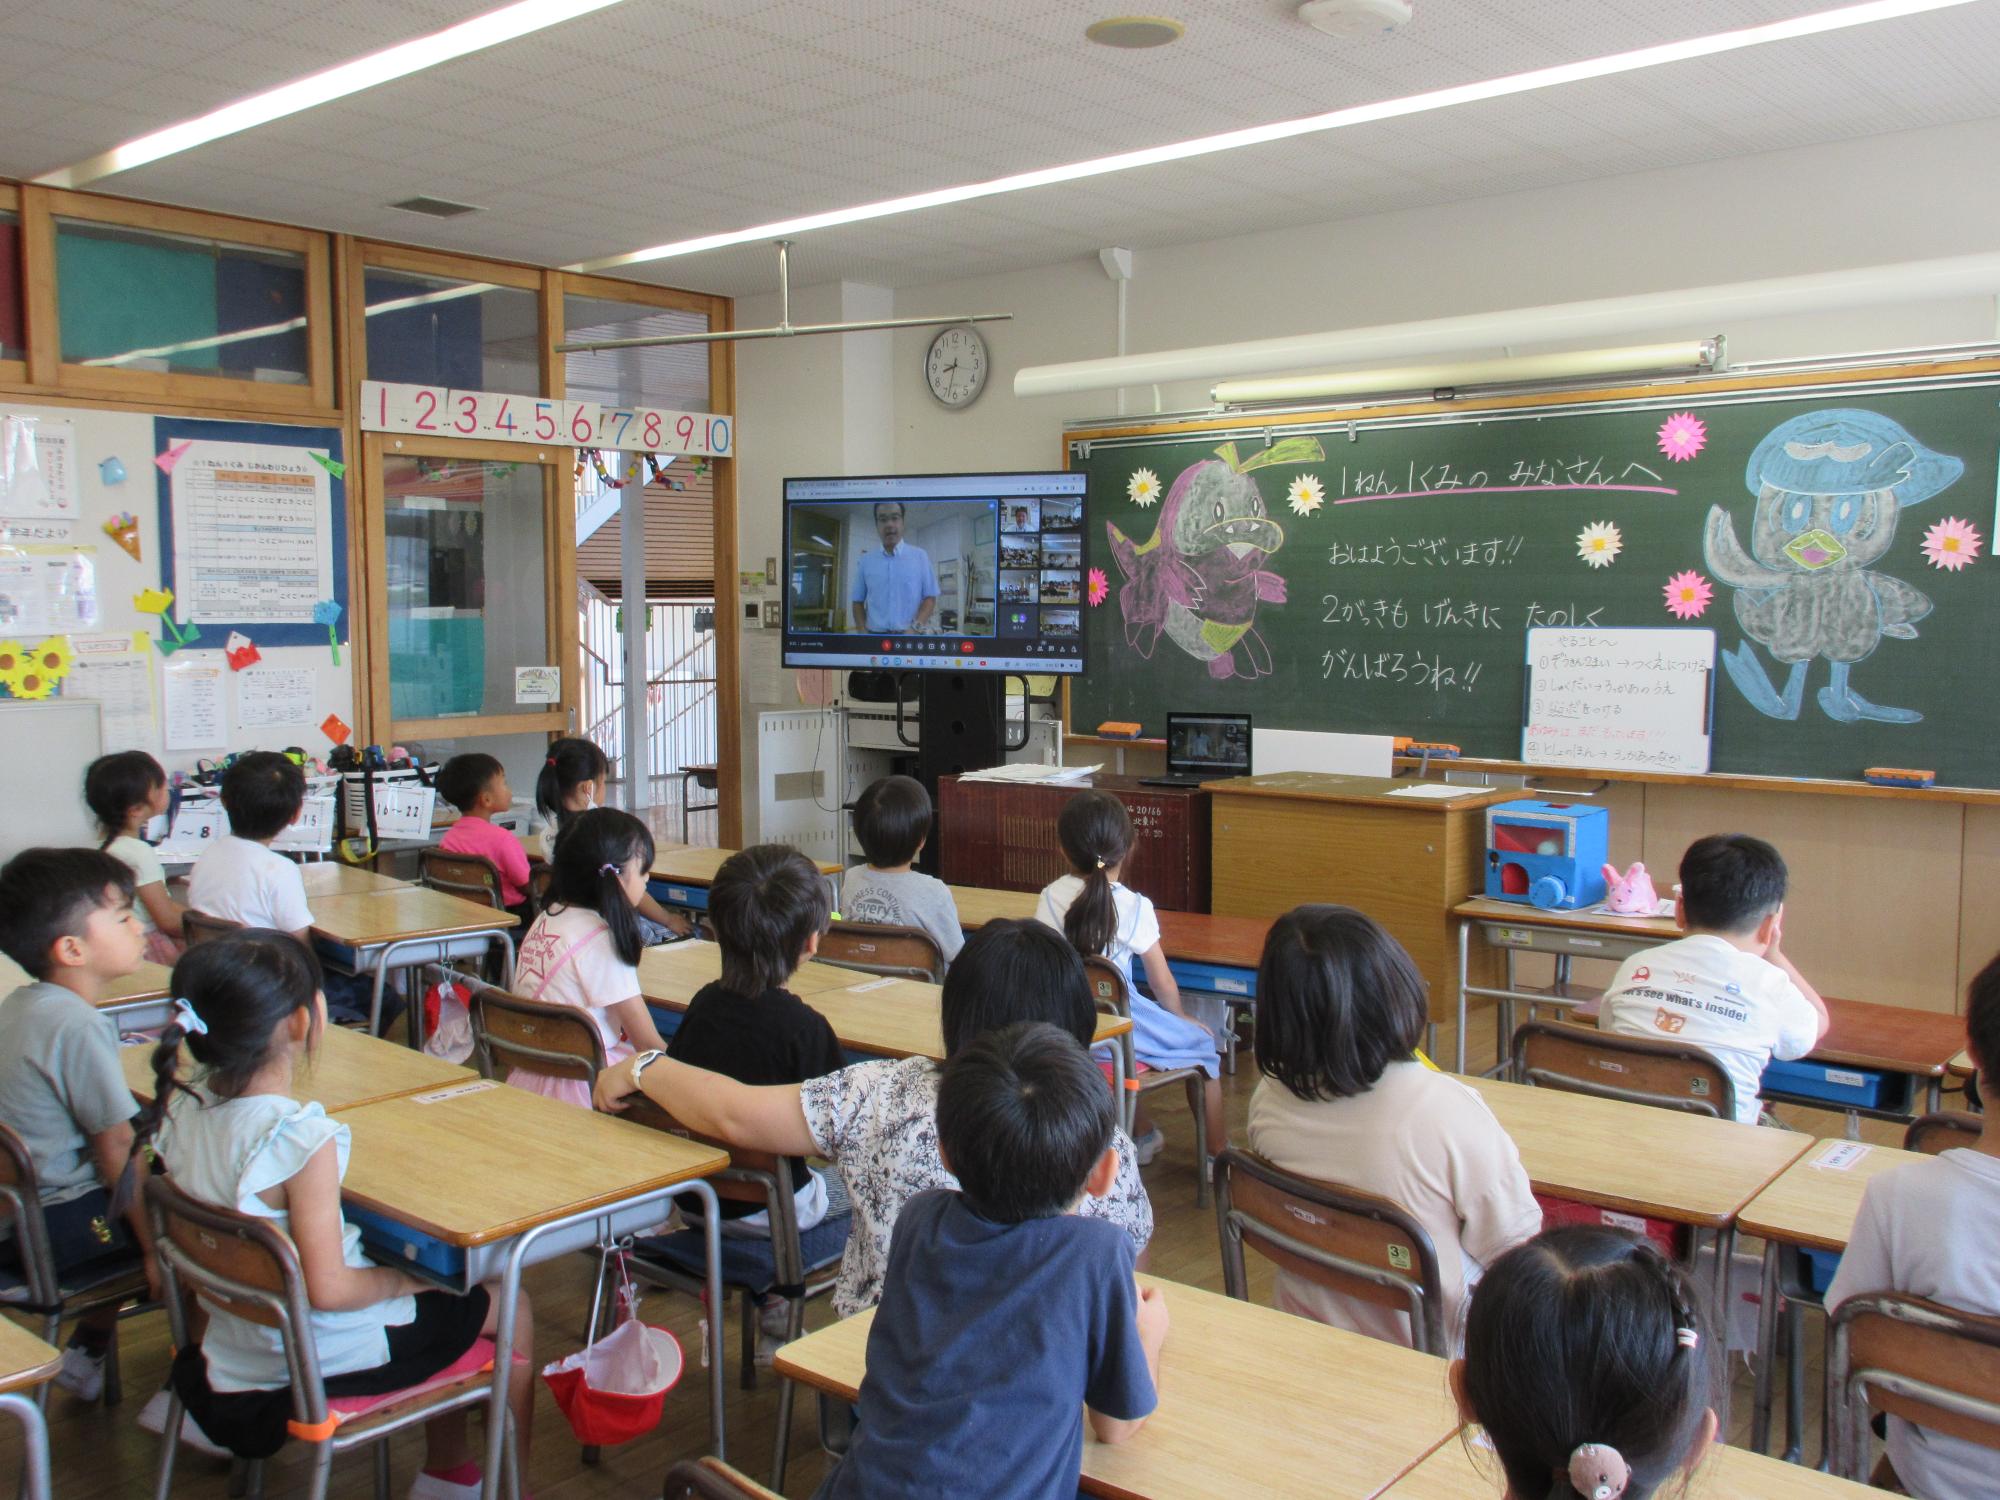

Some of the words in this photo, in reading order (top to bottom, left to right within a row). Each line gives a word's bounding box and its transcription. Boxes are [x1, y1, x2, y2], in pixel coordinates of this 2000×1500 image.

[380, 387, 387, 427] 1
[415, 390, 438, 430] 2
[454, 395, 478, 434] 3
[495, 399, 518, 436] 4
[535, 403, 555, 440] 5
[571, 404, 593, 442] 6
[611, 412, 634, 445] 7
[643, 412, 661, 448] 8
[676, 415, 695, 450] 9
[705, 418, 730, 453] 10
[1322, 594, 1408, 630] 2がっきも
[1424, 598, 1502, 631] げんきに
[1526, 601, 1605, 628] たのしく
[1322, 648, 1483, 692] がんばろうね!!
[856, 902, 893, 919] every
[1643, 989, 1664, 1000] see
[1666, 992, 1703, 1009] what's
[1705, 1001, 1747, 1023] inside!
[1692, 1078, 1700, 1087] 3
[1390, 1246, 1399, 1257] 3
